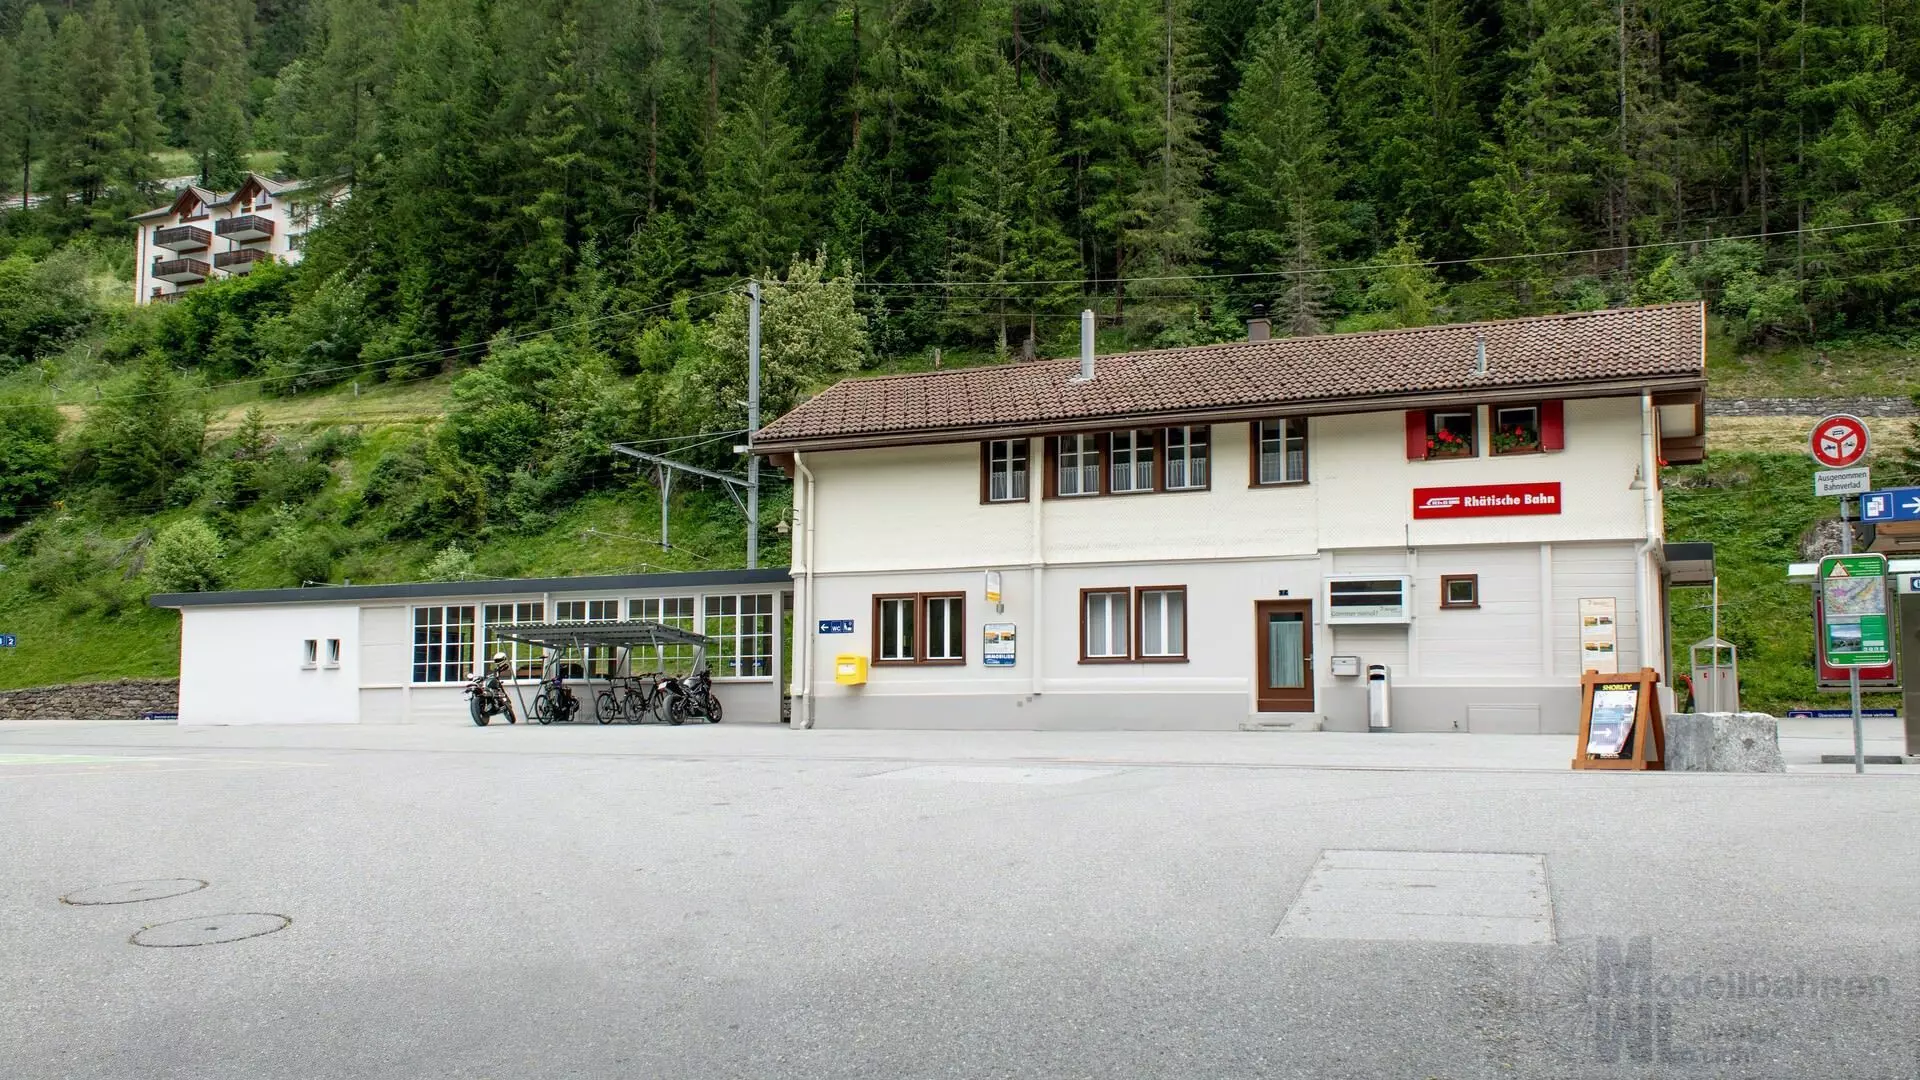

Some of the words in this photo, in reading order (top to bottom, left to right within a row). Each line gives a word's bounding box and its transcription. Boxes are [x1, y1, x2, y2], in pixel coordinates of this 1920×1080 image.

[1817, 472, 1867, 482] Ausgenommen
[1823, 481, 1861, 491] Bahnverlad
[1464, 495, 1520, 507] Rhätische
[1524, 493, 1555, 505] Bahn
